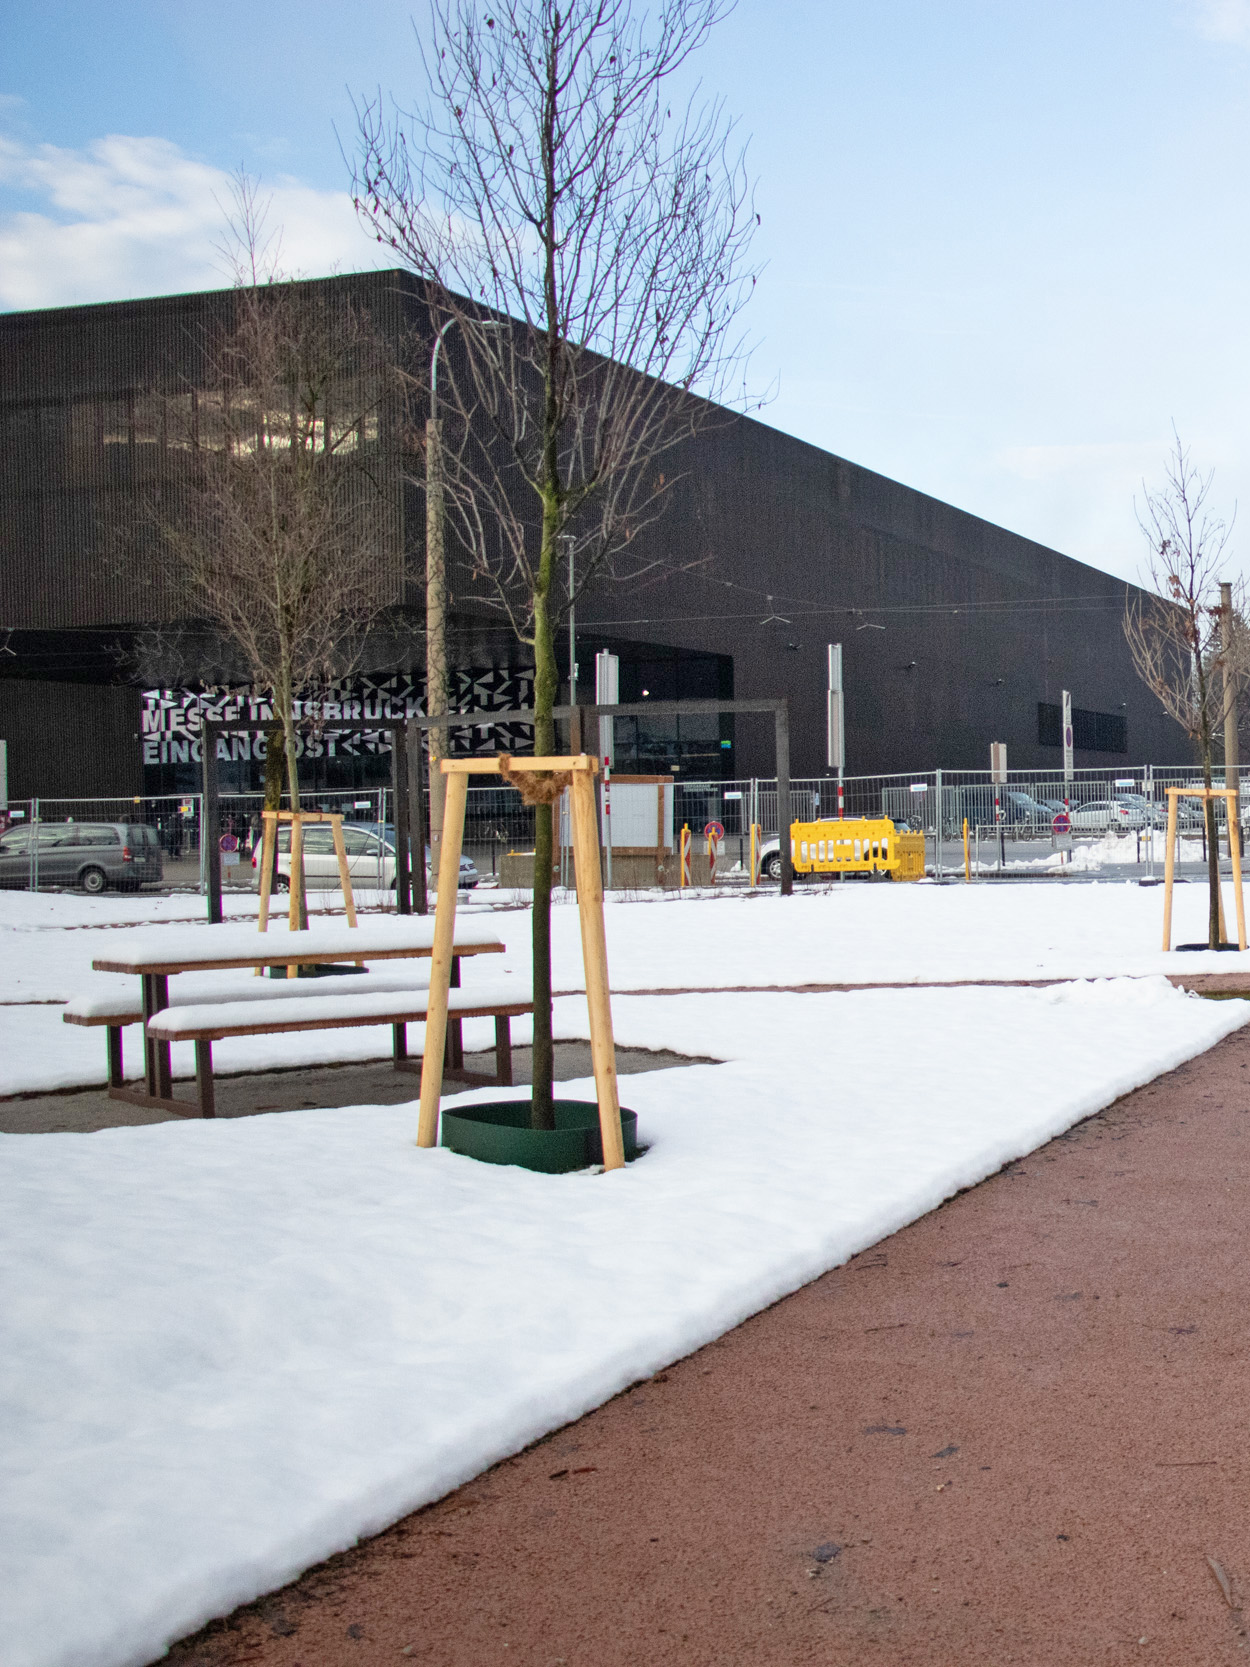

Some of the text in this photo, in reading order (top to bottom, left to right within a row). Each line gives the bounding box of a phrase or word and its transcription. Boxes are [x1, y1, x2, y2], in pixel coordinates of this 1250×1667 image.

[142, 705, 240, 732] MESSE
[143, 733, 340, 764] EINGANG OST
